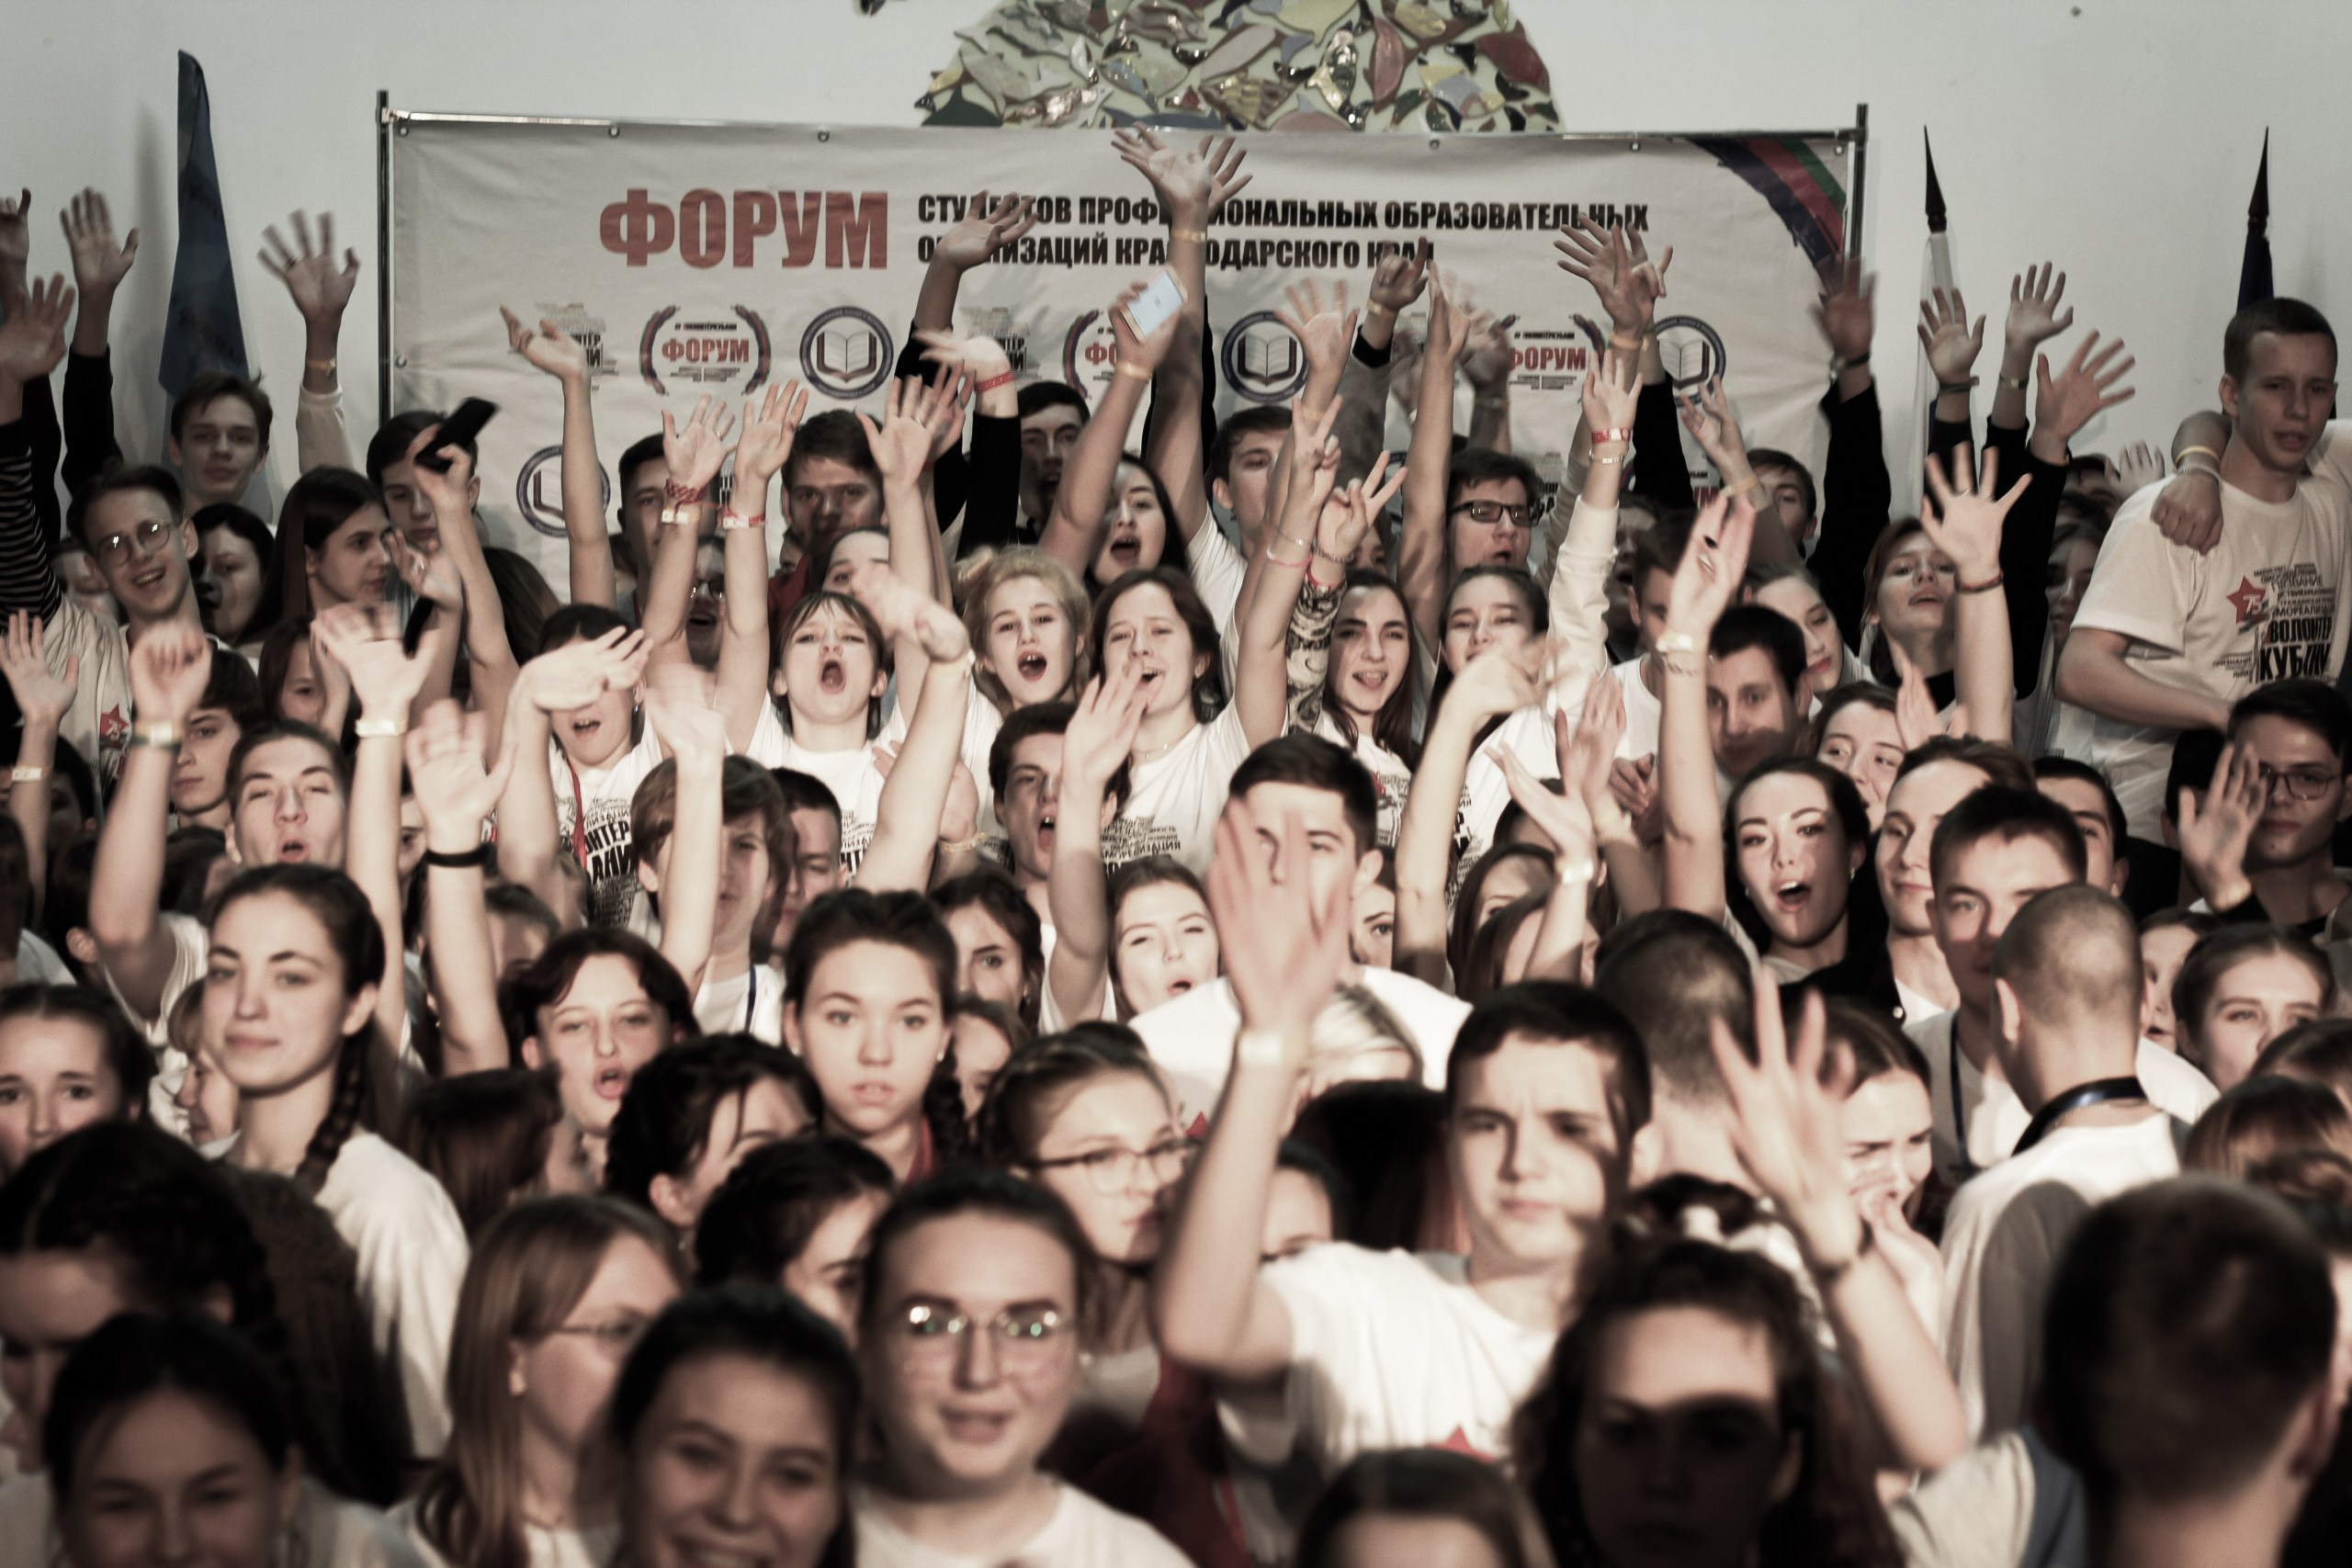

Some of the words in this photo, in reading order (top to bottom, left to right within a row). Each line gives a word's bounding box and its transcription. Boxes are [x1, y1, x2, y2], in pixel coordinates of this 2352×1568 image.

[599, 187, 889, 270] ФОРУМ
[1385, 199, 1650, 232] ОБРАЗОВАТЕЛЬНЫХ
[1114, 236, 1362, 269] КРАОДАРСКОГО
[662, 337, 750, 364] ФОРУМ
